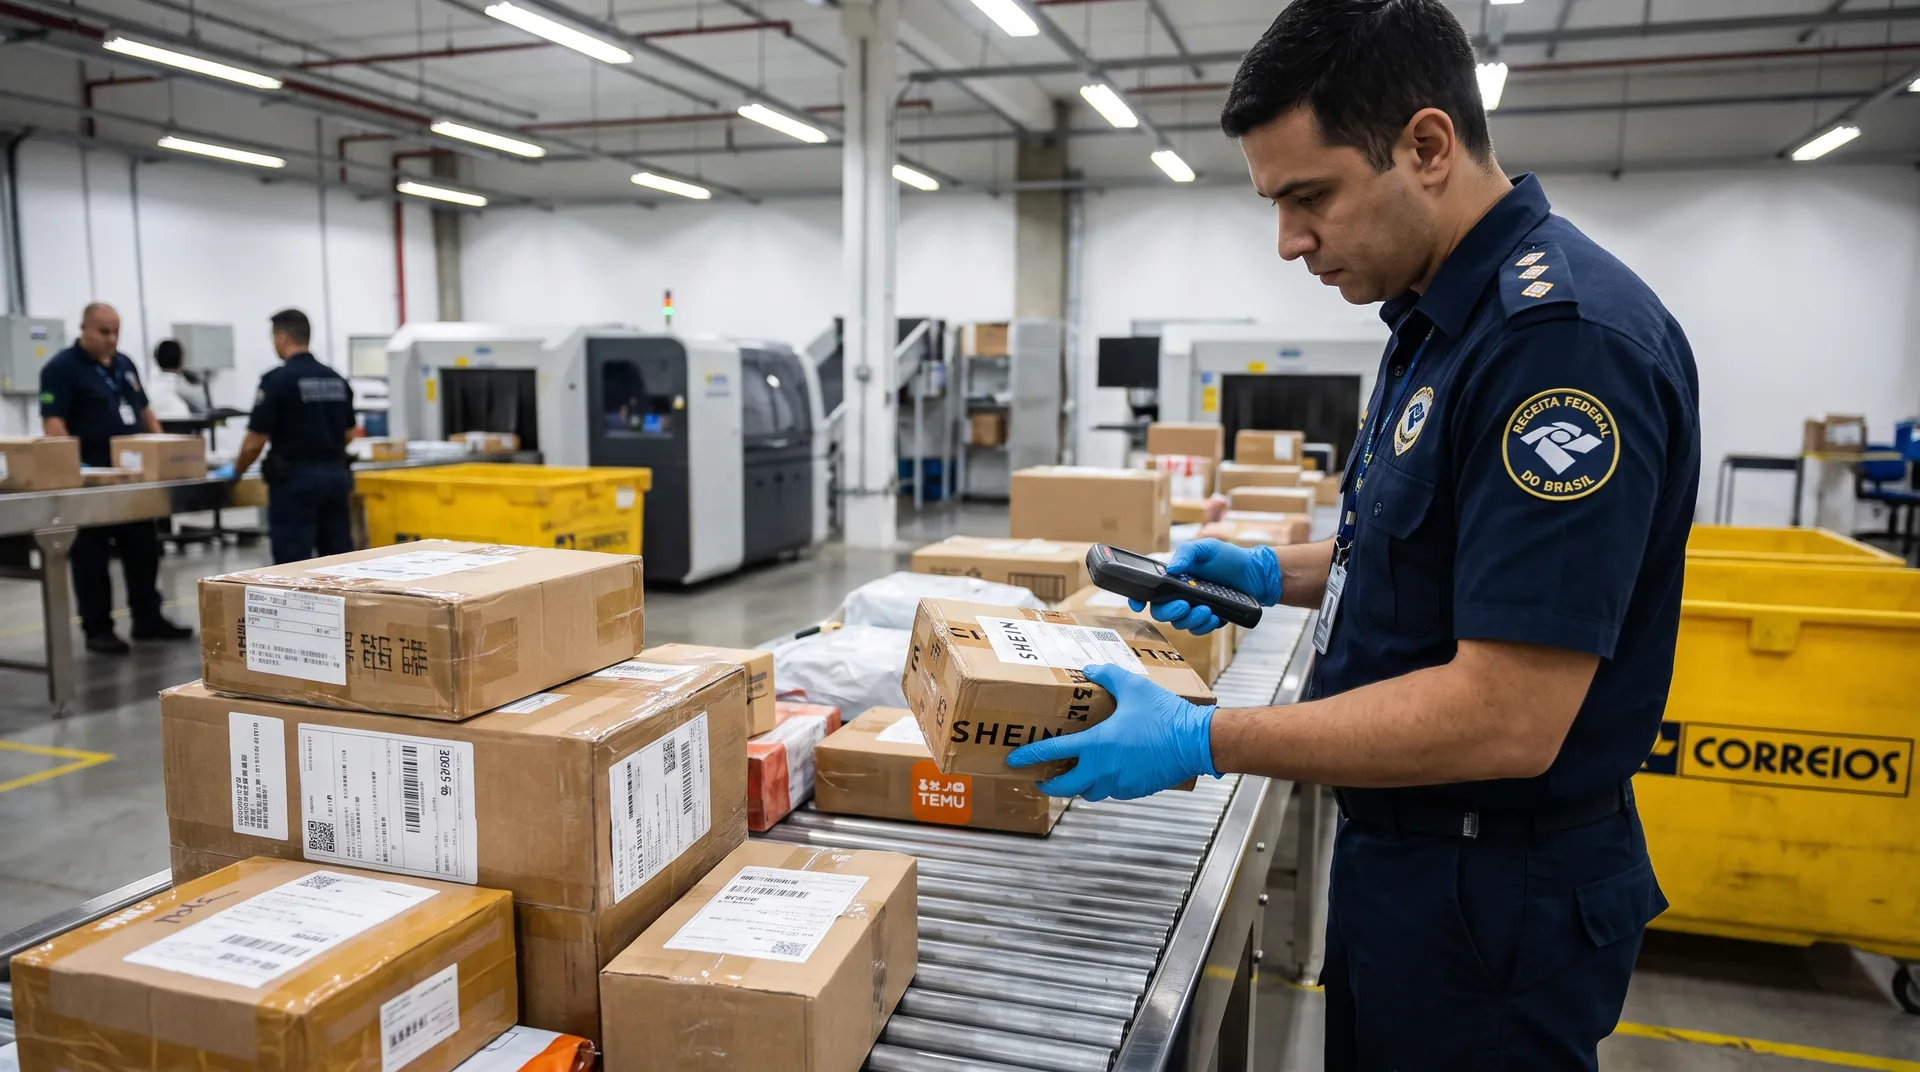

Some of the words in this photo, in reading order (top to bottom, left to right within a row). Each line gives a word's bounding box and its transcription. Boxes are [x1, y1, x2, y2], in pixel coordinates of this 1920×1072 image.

[1512, 397, 1560, 434] RECEITA
[1564, 396, 1611, 438] FEDERAL
[1520, 470, 1540, 487] DO
[1543, 475, 1595, 493] BRASIL
[999, 621, 1038, 660] SHEIN
[1693, 737, 1901, 784] CORREIOS
[918, 792, 965, 809] TEMU
